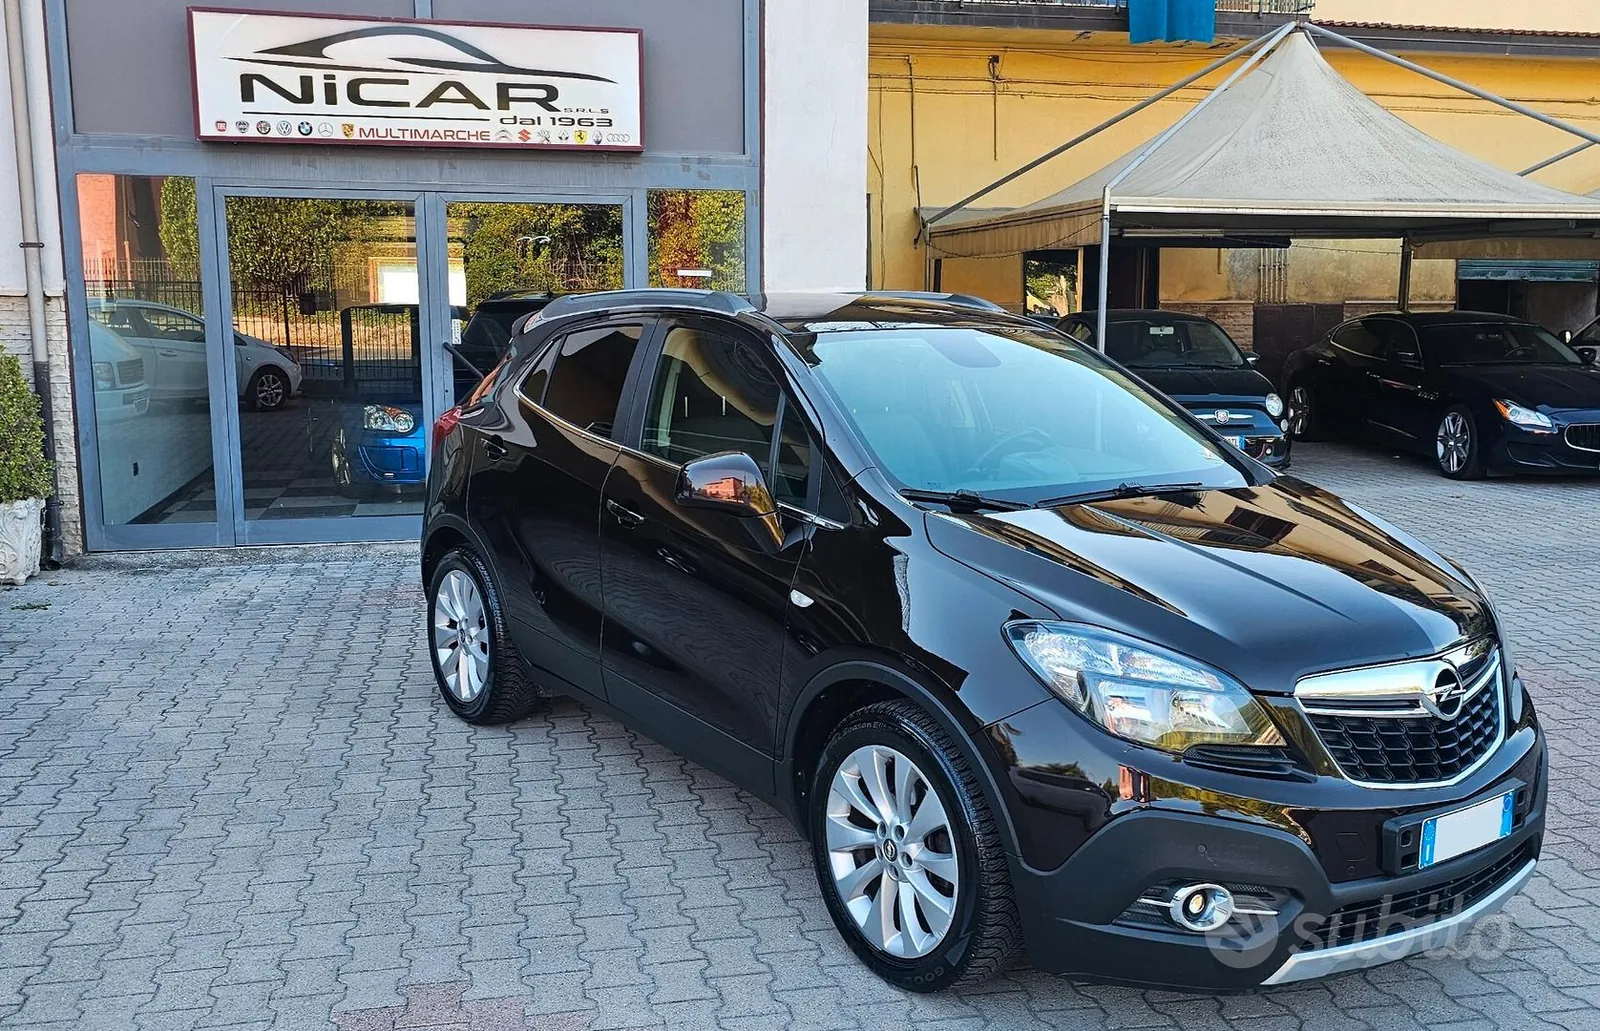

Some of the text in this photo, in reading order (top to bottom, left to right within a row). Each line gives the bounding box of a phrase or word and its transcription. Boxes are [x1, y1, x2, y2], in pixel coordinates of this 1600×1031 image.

[500, 115, 613, 127] dal 1963
[359, 127, 490, 141] MULTIMARCHE
